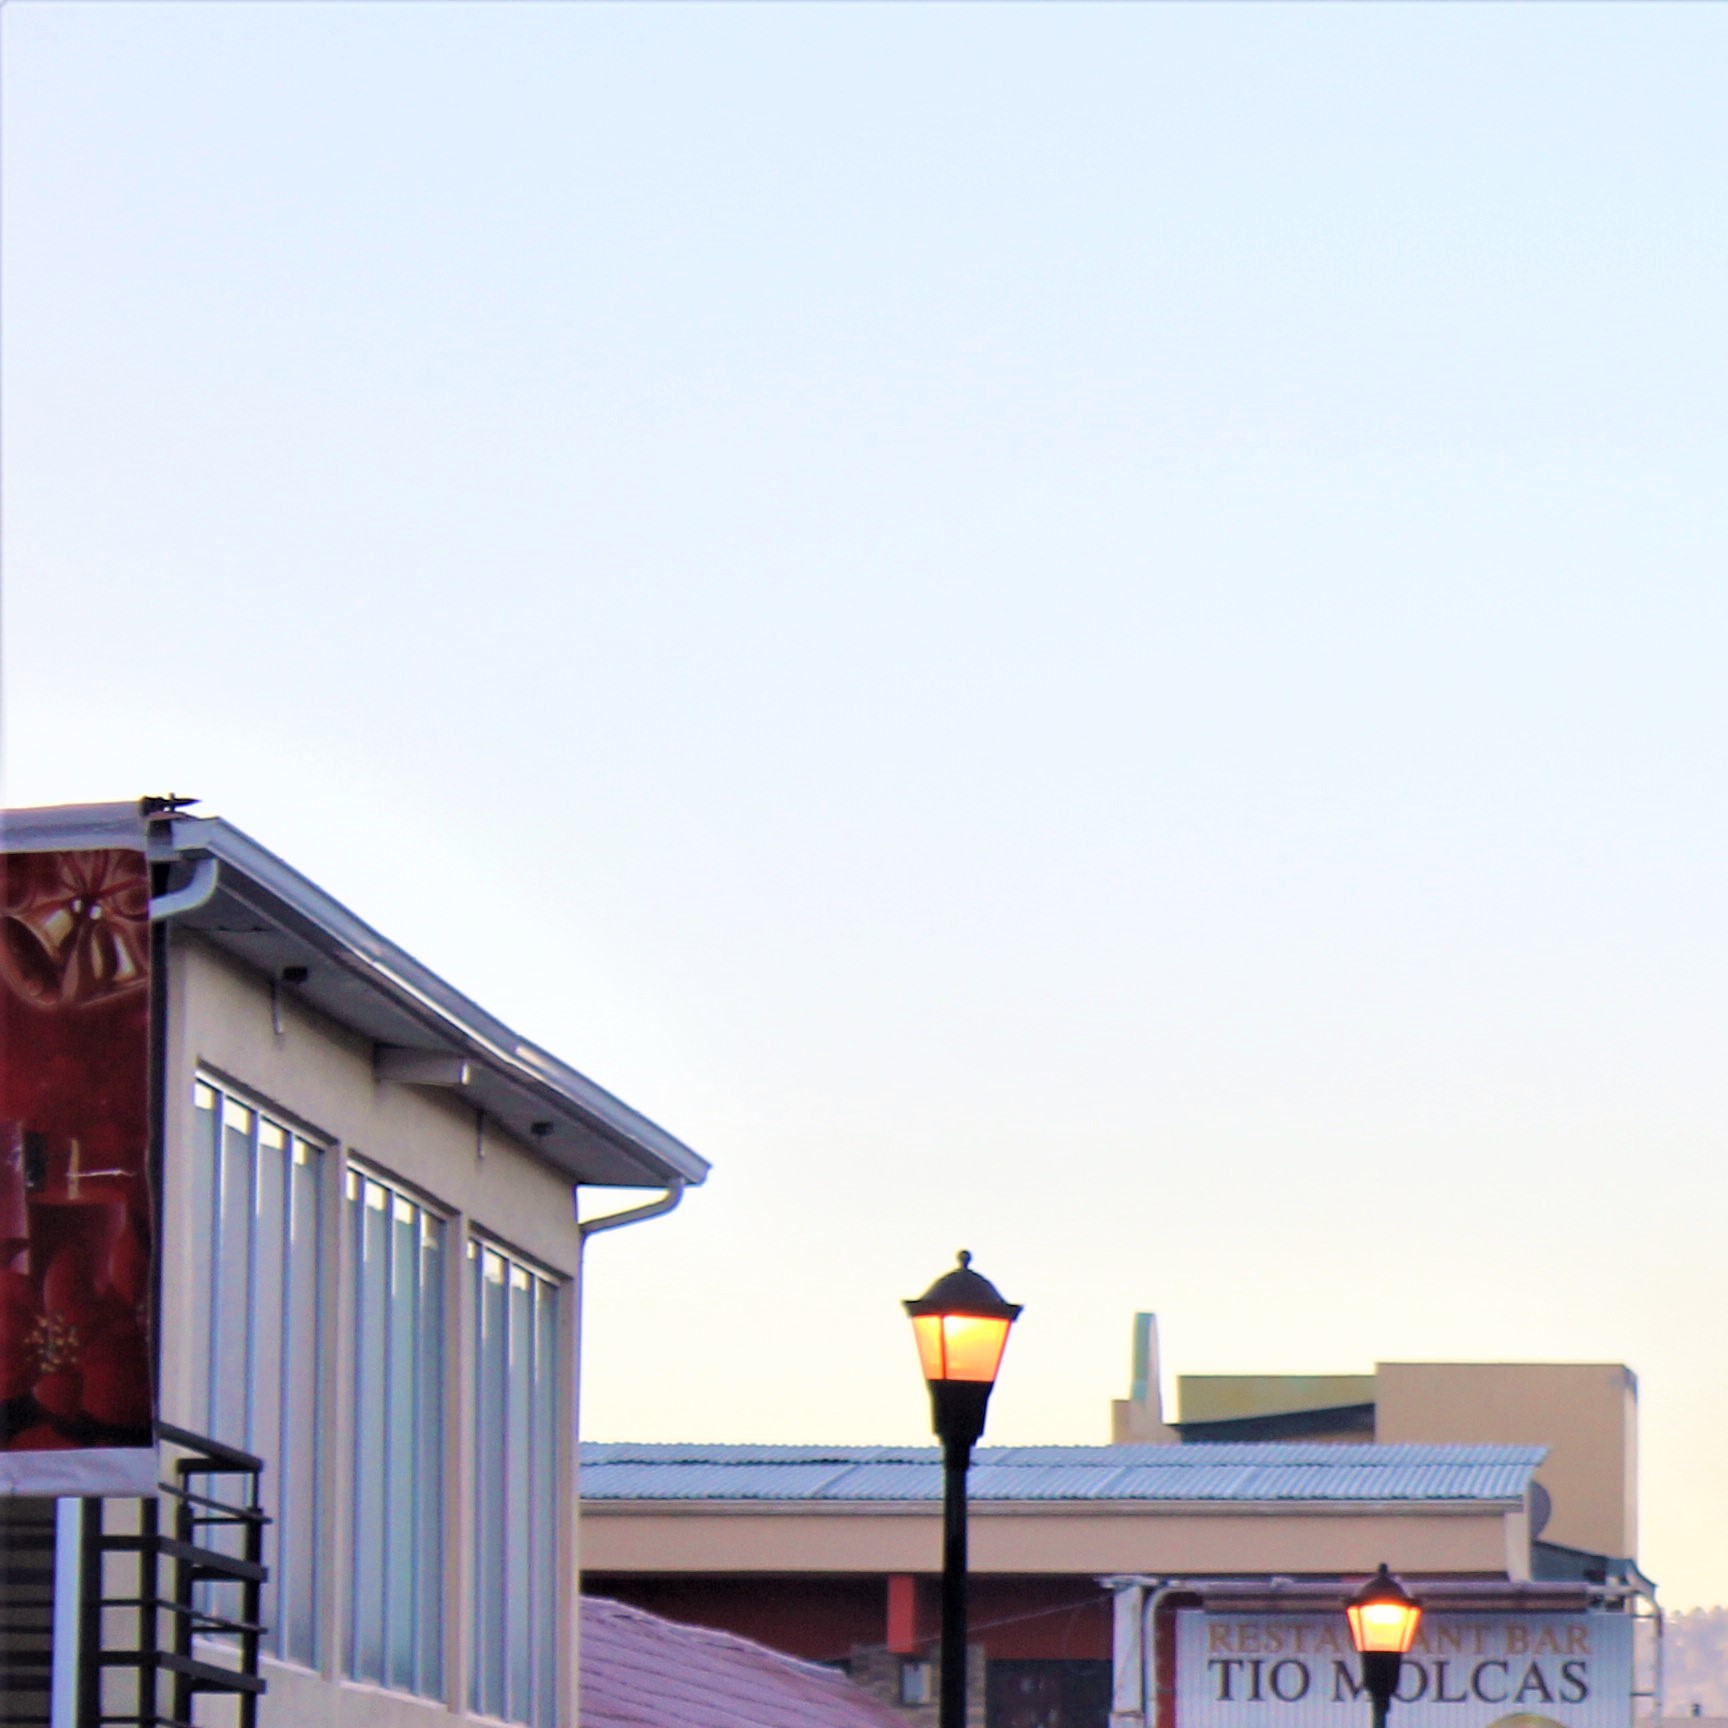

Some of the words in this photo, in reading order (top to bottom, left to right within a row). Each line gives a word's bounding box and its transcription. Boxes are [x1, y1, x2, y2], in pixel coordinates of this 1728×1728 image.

[1208, 1622, 1492, 1654] RESTAANT
[1505, 1622, 1591, 1655] BAR
[1208, 1658, 1311, 1702] TIO
[1332, 1658, 1589, 1704] MOLCAS
